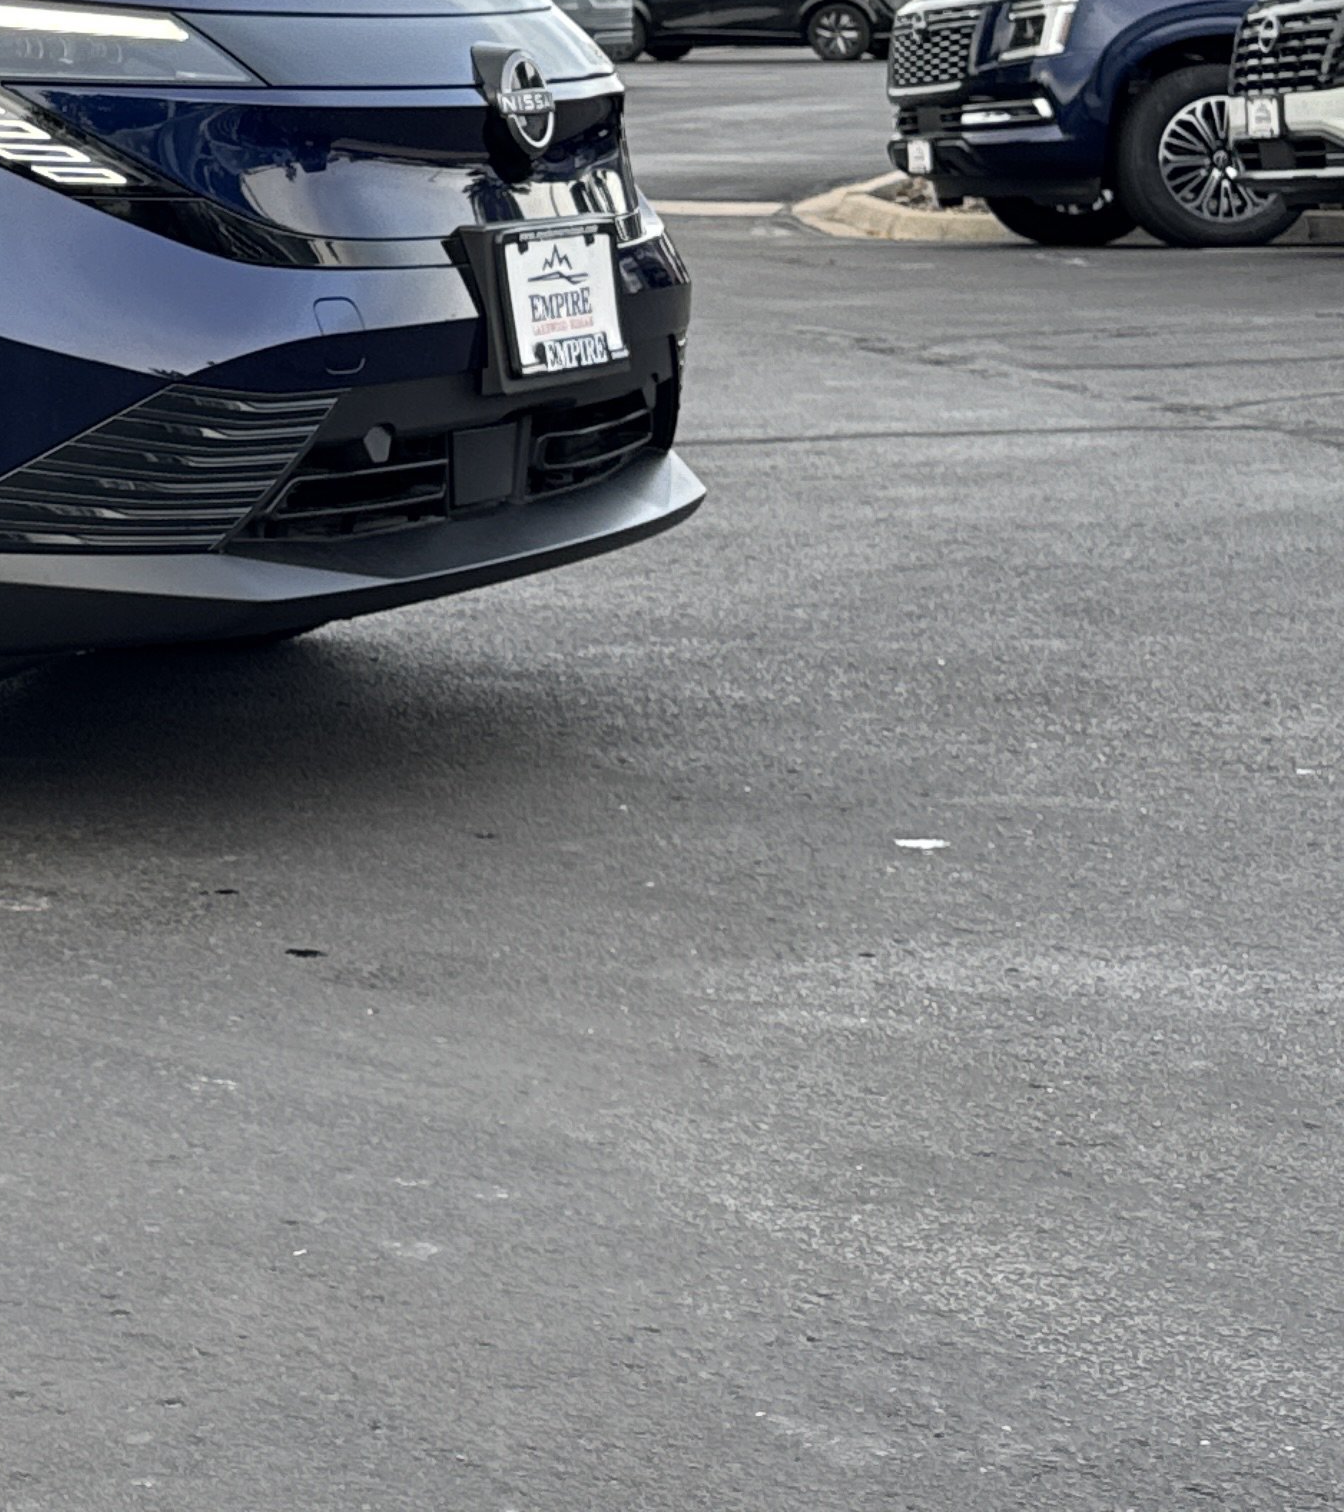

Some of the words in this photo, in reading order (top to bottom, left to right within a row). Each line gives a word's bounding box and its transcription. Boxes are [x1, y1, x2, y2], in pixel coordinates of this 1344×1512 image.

[501, 92, 552, 113] NISSA
[528, 287, 593, 322] EMPIRE
[543, 333, 609, 372] EMPIRE
